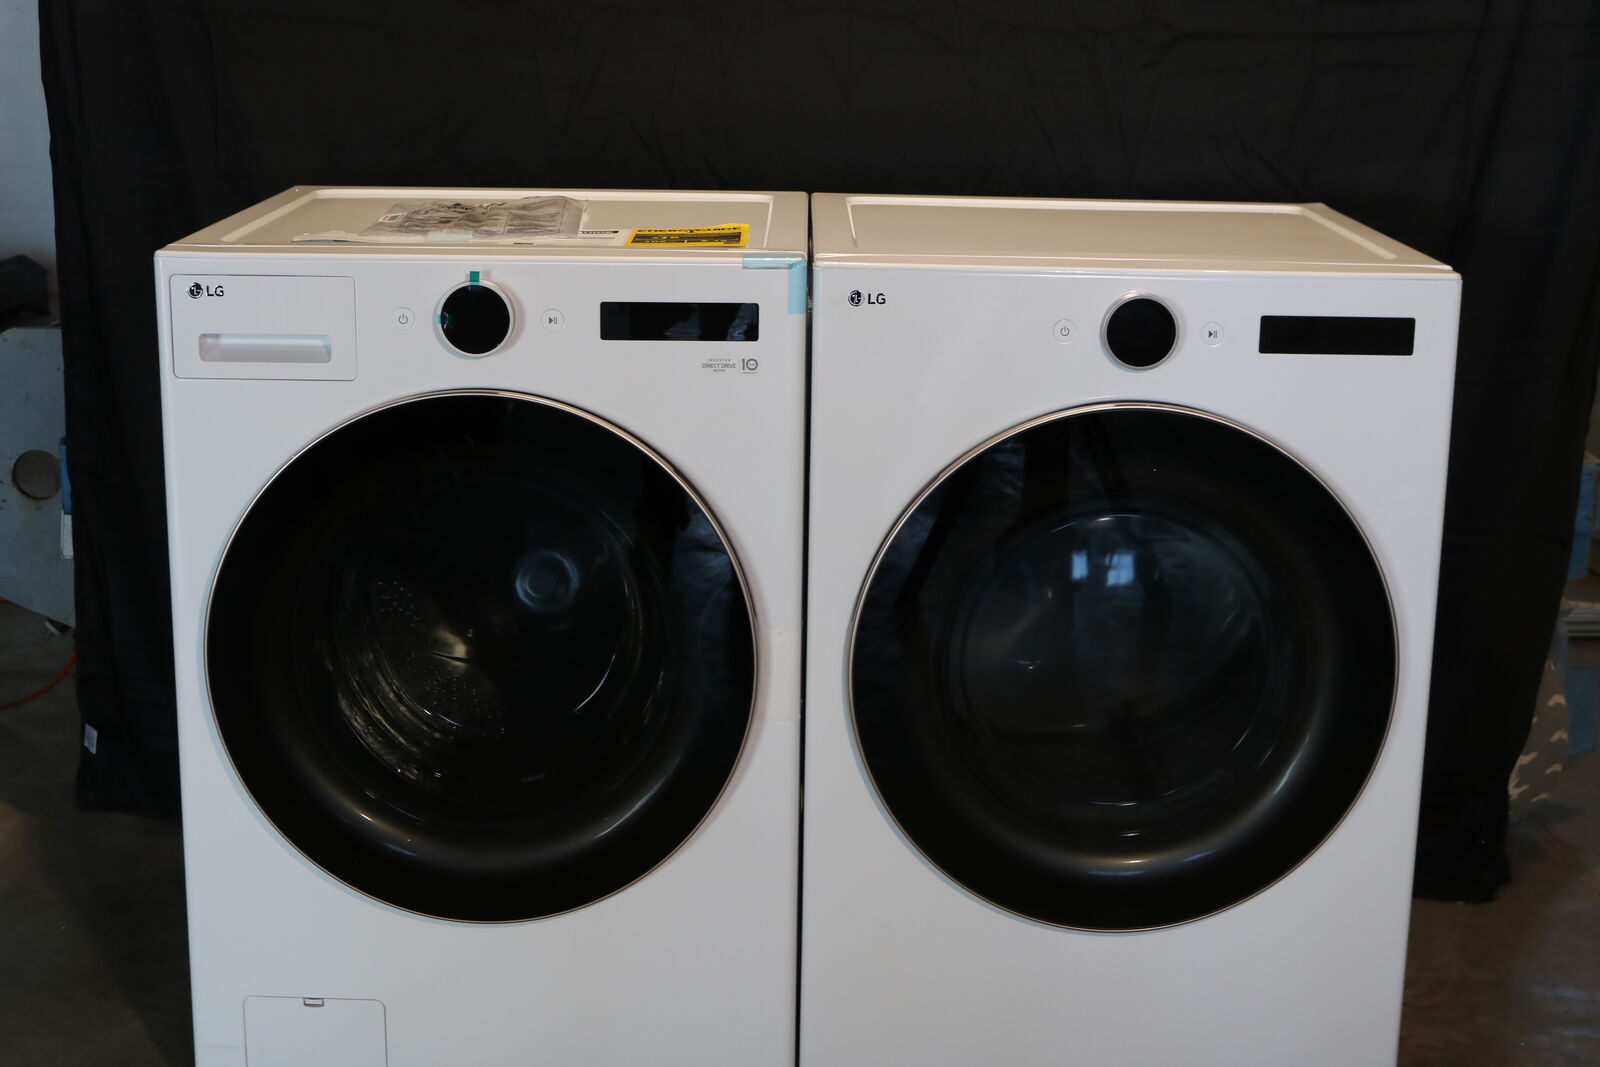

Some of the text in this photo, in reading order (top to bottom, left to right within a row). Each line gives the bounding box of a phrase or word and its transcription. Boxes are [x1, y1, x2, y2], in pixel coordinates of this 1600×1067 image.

[206, 285, 225, 297] LG
[867, 293, 886, 305] LG
[742, 358, 759, 371] 10
